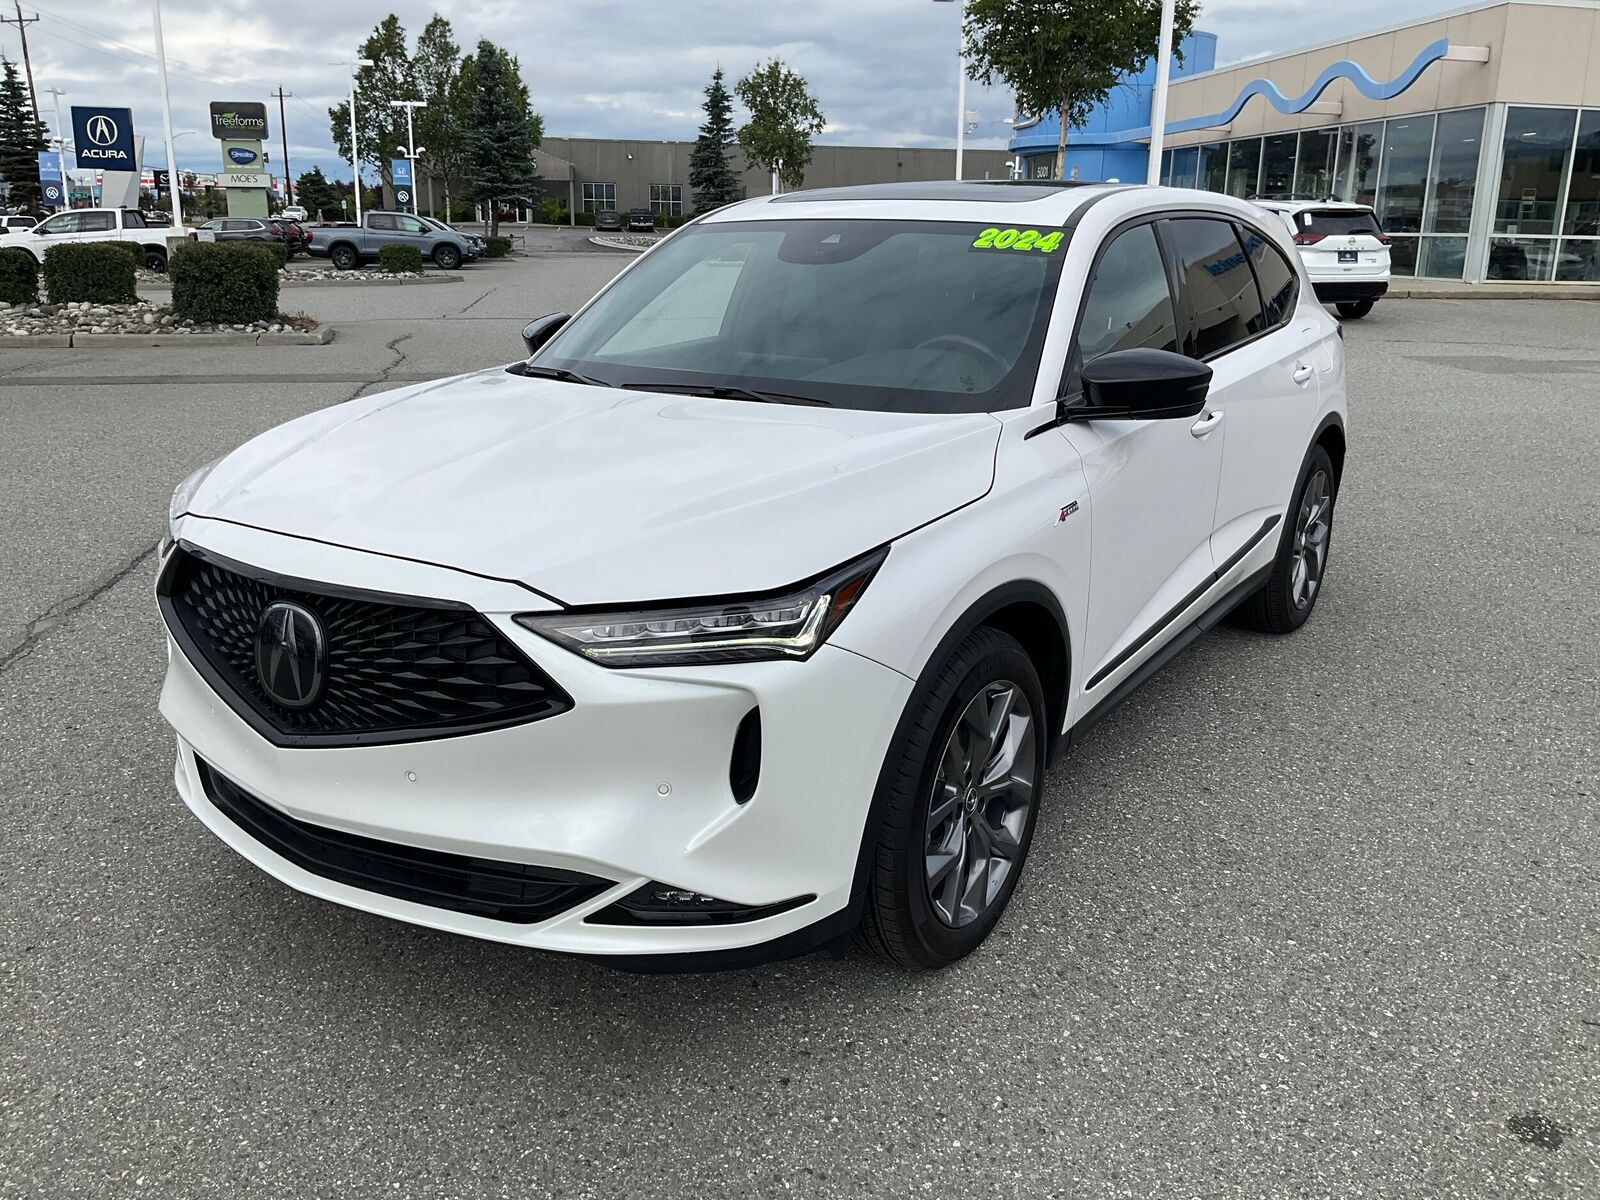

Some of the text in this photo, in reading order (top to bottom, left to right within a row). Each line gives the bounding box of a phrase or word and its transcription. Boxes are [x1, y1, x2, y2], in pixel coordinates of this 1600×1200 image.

[212, 114, 264, 126] Treeforms
[81, 149, 127, 159] ACURA
[230, 175, 258, 183] MOE'S
[972, 228, 1065, 253] 2024
